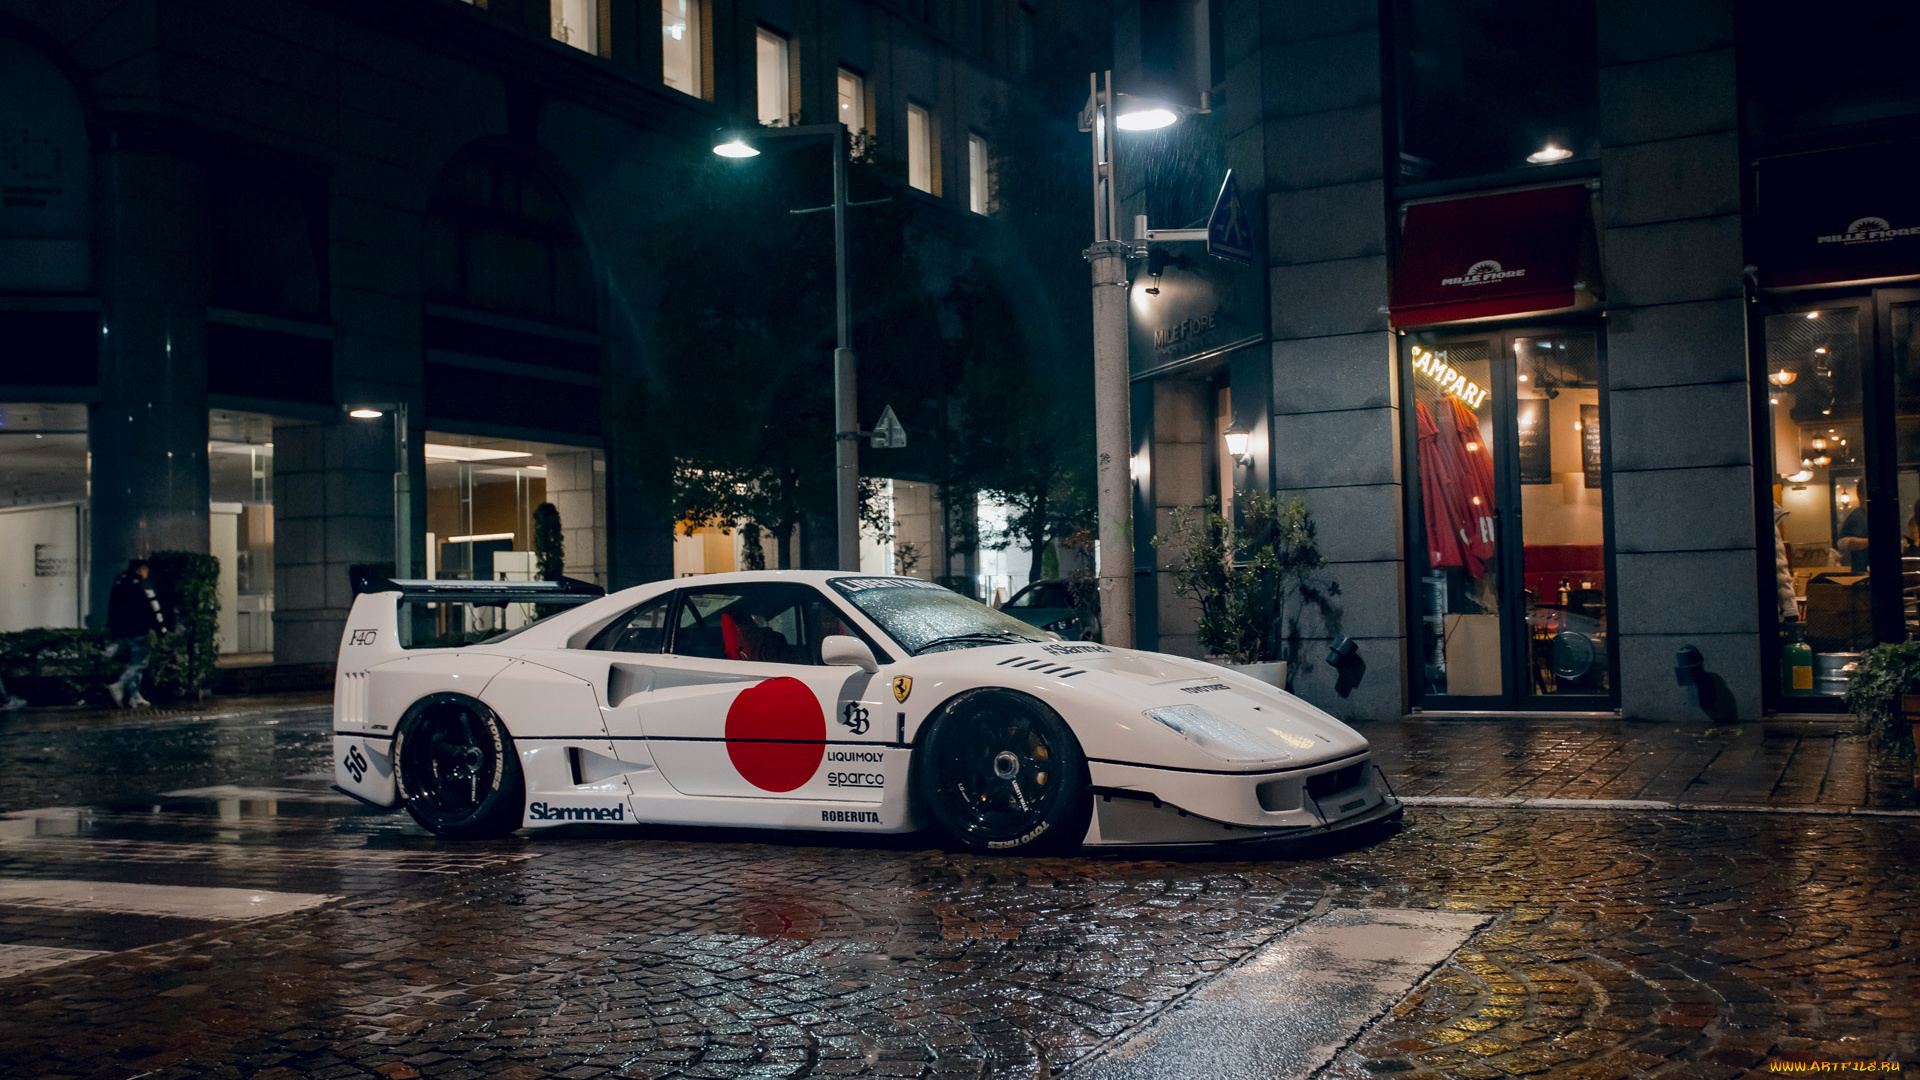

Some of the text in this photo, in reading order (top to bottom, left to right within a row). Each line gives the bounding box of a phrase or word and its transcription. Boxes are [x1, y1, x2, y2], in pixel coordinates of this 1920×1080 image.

[1817, 227, 1920, 243] MILLE FIORE
[1442, 269, 1526, 285] MILLE FIORE
[1181, 313, 1216, 338] FIORE
[349, 629, 378, 646] F40
[343, 745, 368, 783] 56
[827, 772, 885, 787] sparco
[529, 802, 624, 821] Slammed
[1022, 821, 1049, 842] TOYO
